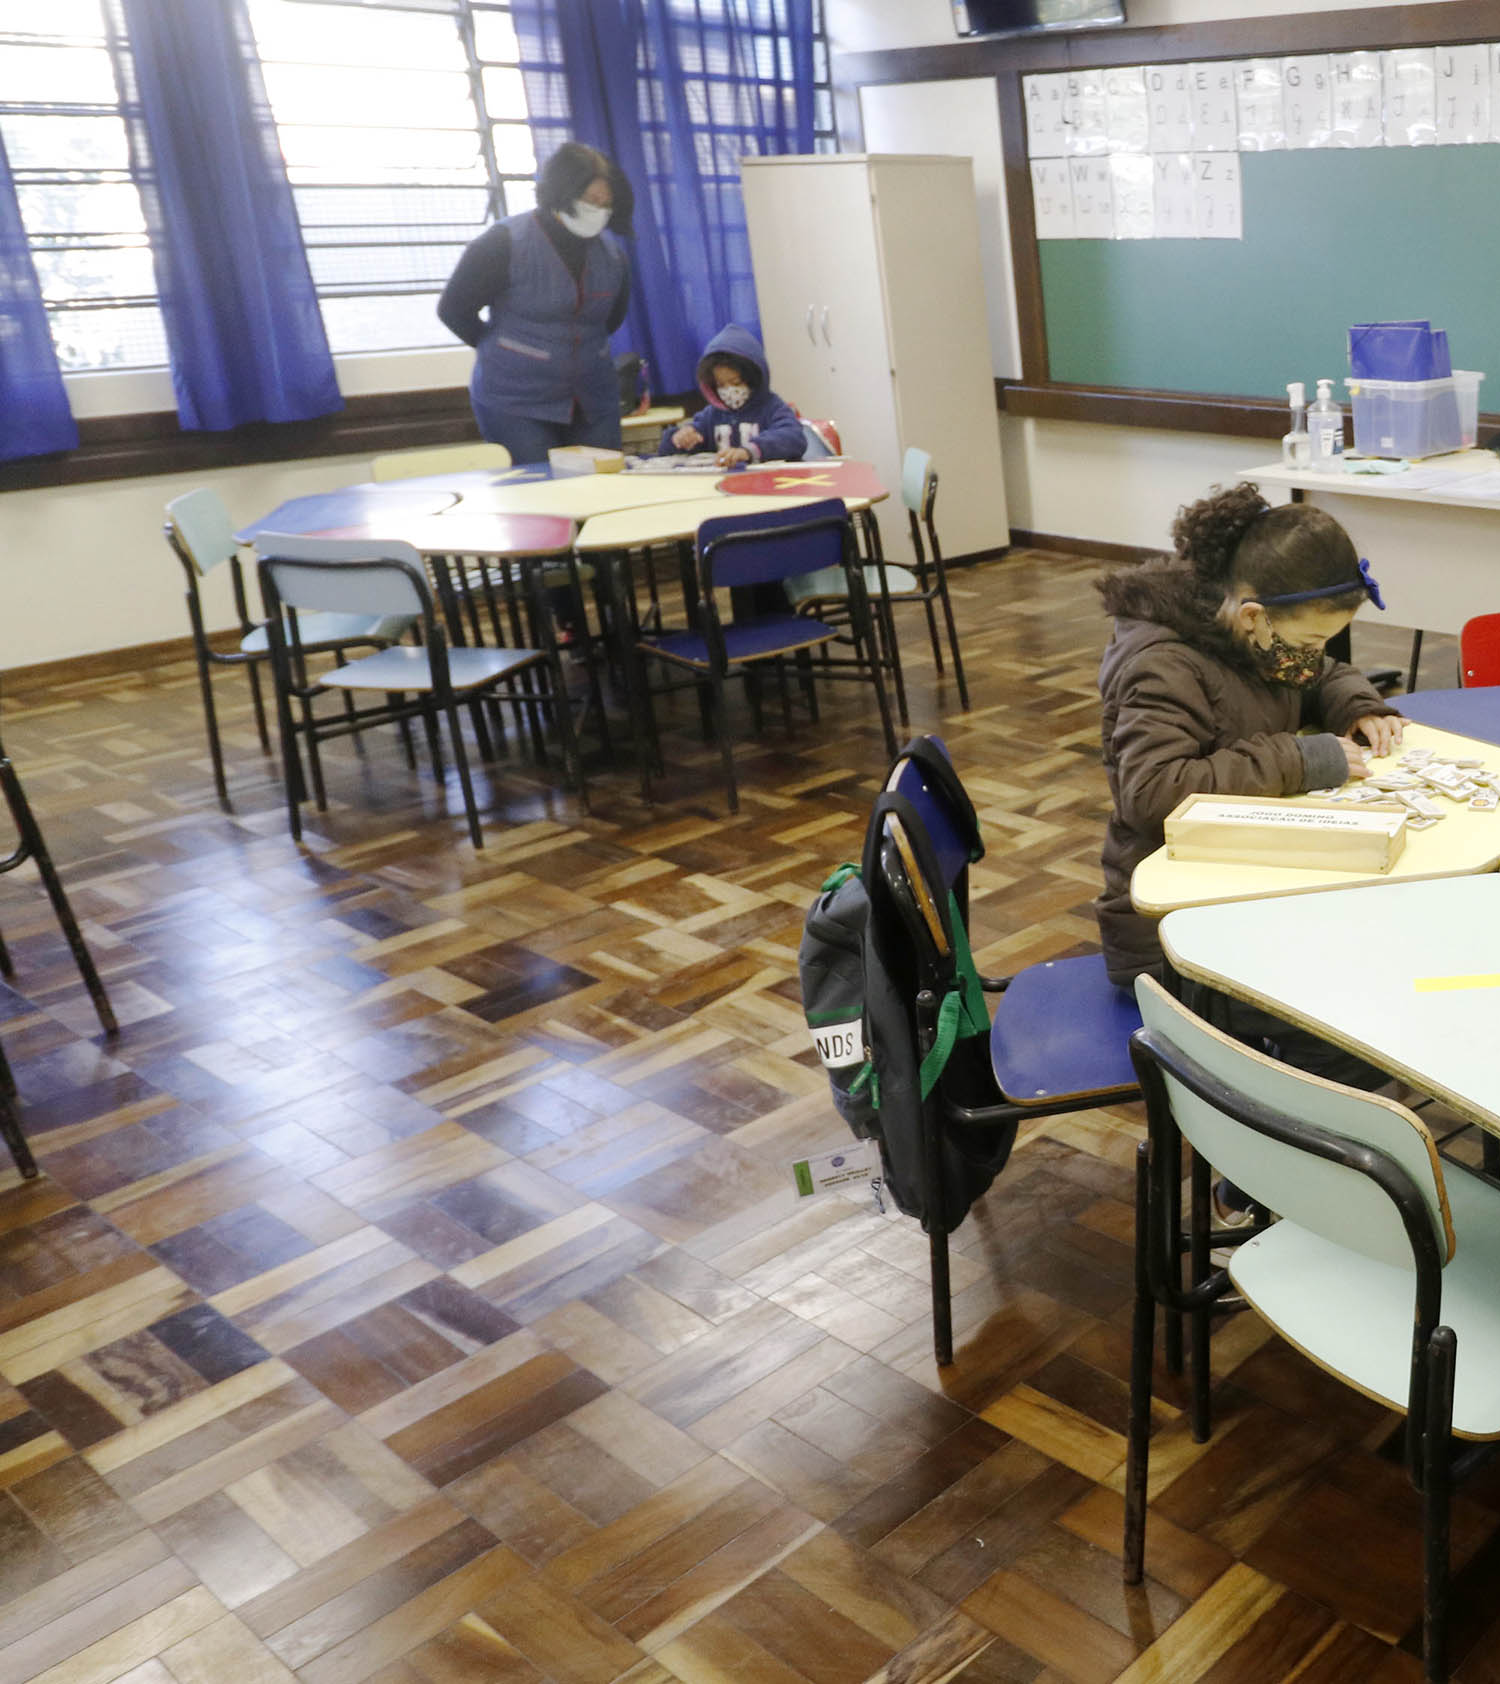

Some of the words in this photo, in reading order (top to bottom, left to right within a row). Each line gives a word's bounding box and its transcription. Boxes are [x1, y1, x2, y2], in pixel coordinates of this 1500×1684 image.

[1286, 66, 1301, 87] G
[1336, 64, 1350, 83] H
[1443, 56, 1454, 78] J
[1068, 78, 1080, 96] B
[1152, 73, 1163, 91] D
[1176, 75, 1185, 91] d
[1196, 72, 1208, 90] E
[1243, 69, 1255, 90] F
[1035, 167, 1047, 184] V
[1073, 165, 1089, 183] W
[1157, 160, 1169, 179] Y
[1201, 160, 1214, 180] Z
[816, 1032, 854, 1060] NDS
